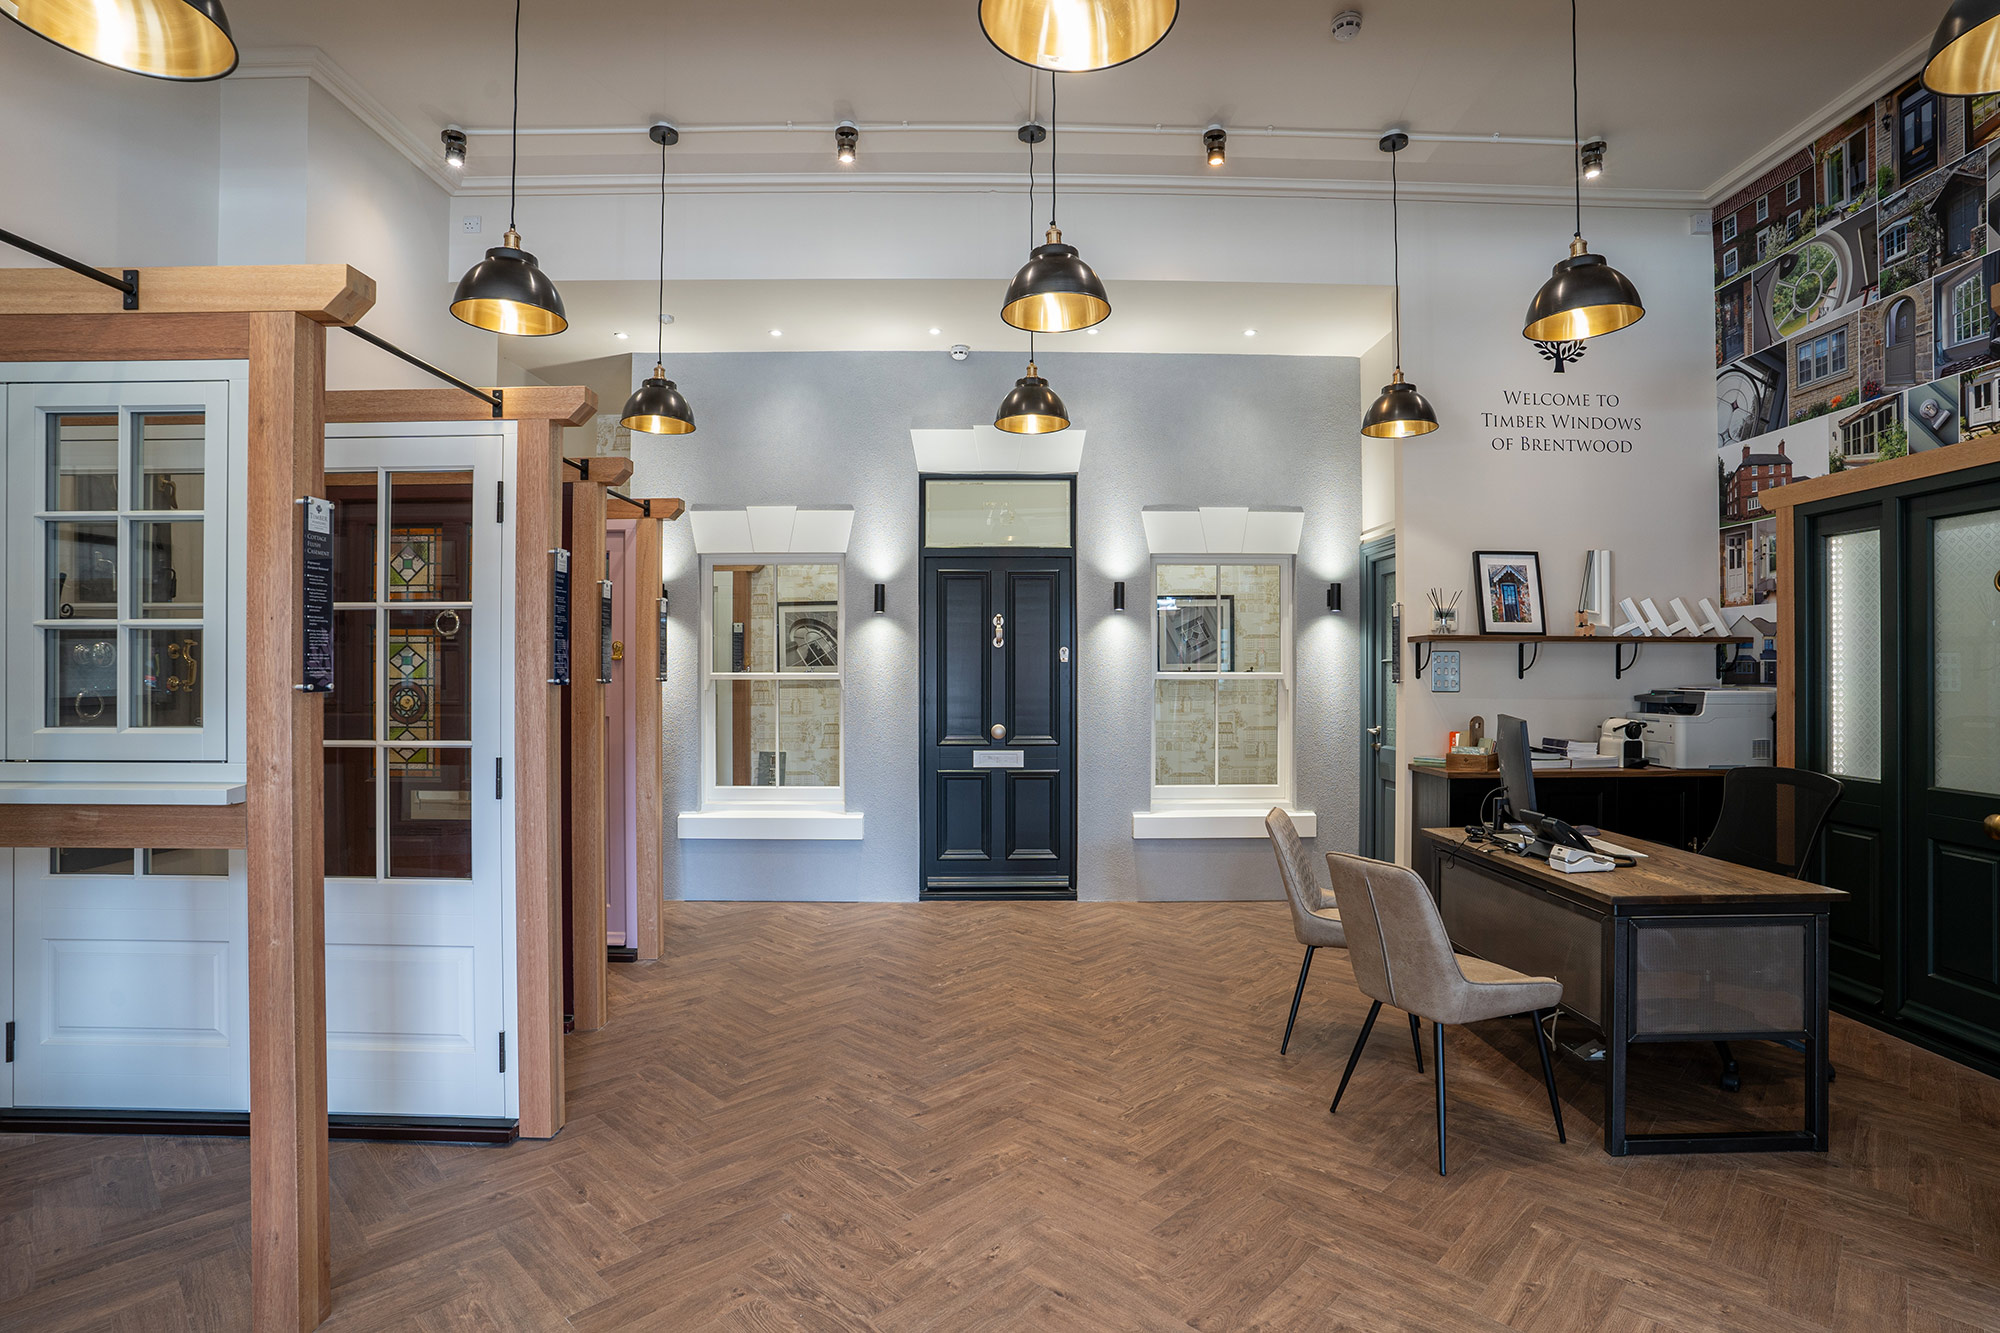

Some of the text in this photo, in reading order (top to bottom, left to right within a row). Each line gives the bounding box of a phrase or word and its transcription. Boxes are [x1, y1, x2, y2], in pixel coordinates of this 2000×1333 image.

[1504, 391, 1619, 407] WELCOME TO
[1481, 413, 1642, 431] TIMBER WINDOWS
[1491, 436, 1633, 453] OF BRENTWOOD
